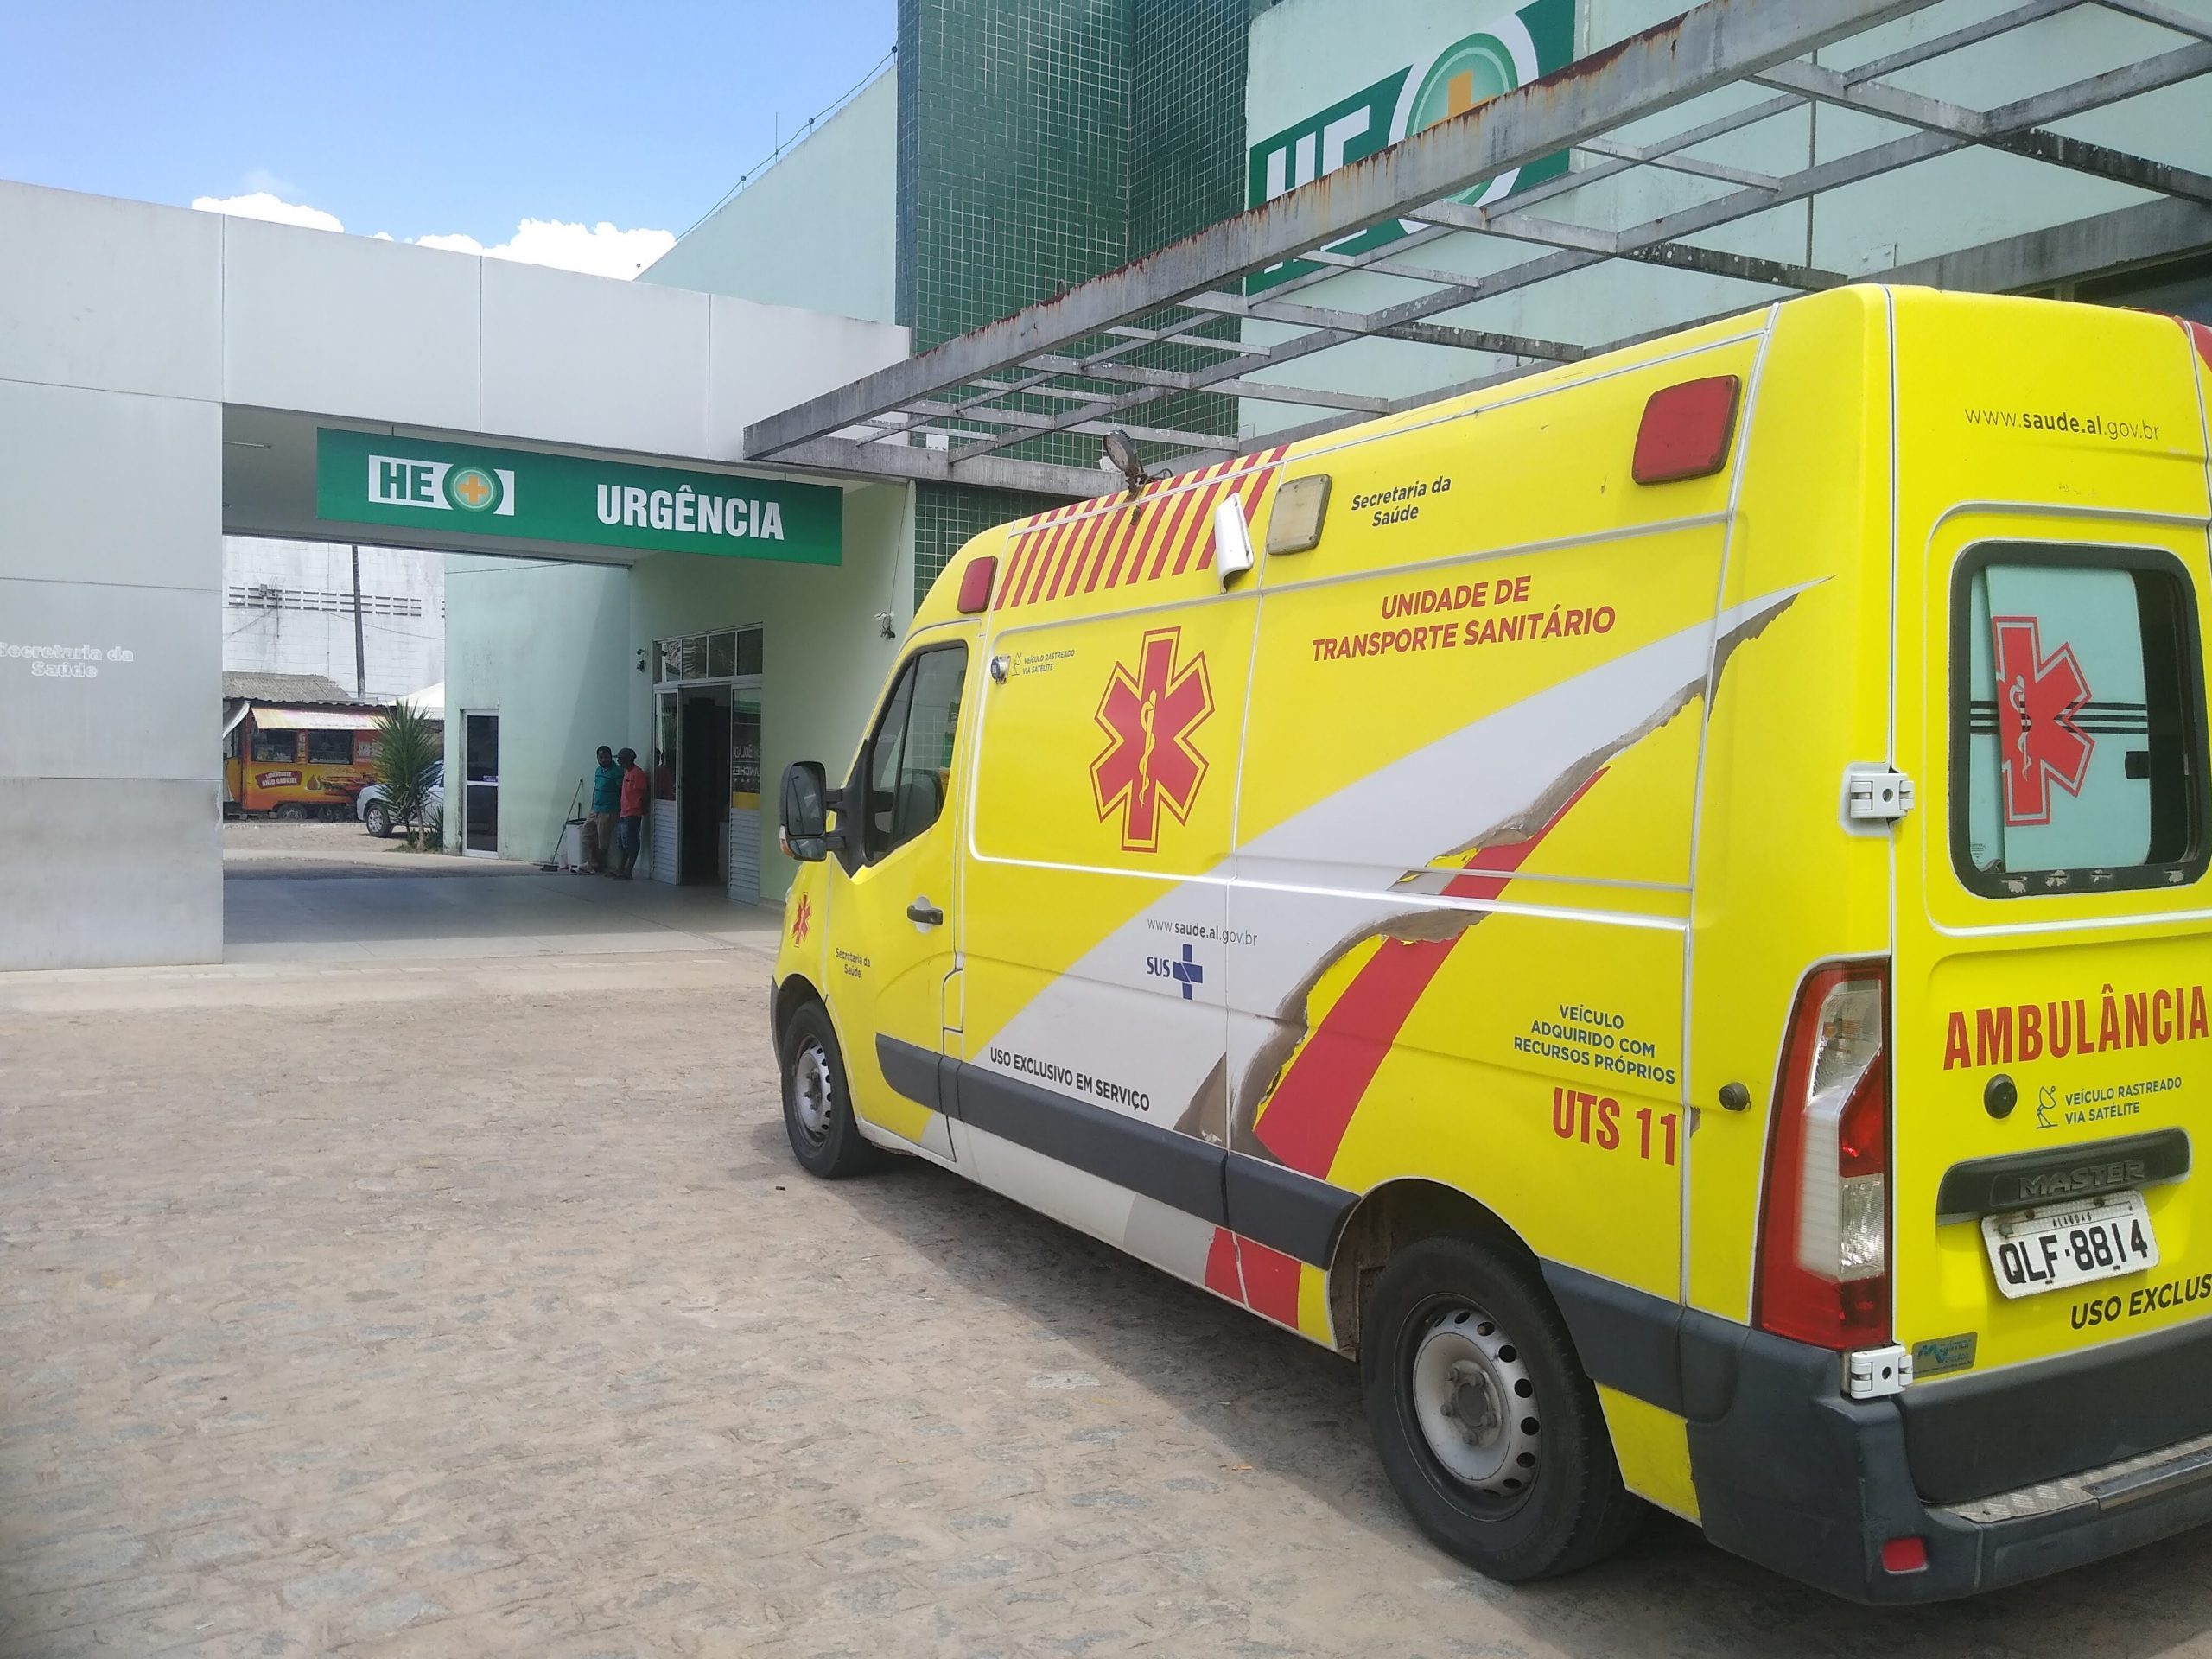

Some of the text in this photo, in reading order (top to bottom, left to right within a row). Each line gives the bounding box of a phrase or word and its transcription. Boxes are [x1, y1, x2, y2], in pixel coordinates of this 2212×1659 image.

[1964, 409, 2159, 441] www.saude.al.gov.br
[1351, 475, 1452, 511] Secretaria da
[596, 484, 785, 541] URGÊNCIA
[1372, 504, 1419, 527] Saúde
[1382, 575, 1531, 620] UNIDADE DE
[1313, 604, 1616, 661] TRANSPORTE SANITÁRIO
[0, 642, 134, 662] Secretaria da
[1024, 650, 1075, 664] VEÍCULO RASTREADO
[31, 661, 99, 678] Saúde
[1032, 663, 1053, 673] SATÉLITE
[1147, 918, 1258, 946] www.saude.al.gov.br
[836, 947, 871, 968] Secretaria da
[844, 963, 861, 979] Saúde
[1147, 956, 1170, 978] SUS
[1559, 1004, 1624, 1029] VEÍCULO
[1943, 983, 2209, 1071] AMBULÂNCIA
[1531, 1020, 1655, 1058] ADQUIRIDO COM
[1514, 1037, 1675, 1084] RECURSOS PRÓPRIOS
[990, 1046, 1150, 1112] USO EXCLUSIVO EM SERVIÇO
[2065, 1077, 2182, 1106] VEÍCULO RASTREADO
[1553, 1086, 1677, 1166] UTS 11
[2065, 1102, 2139, 1124] VIA SATÉLITE
[2018, 1160, 2145, 1199] MASTER
[2071, 1274, 2212, 1329] USO EXCLUS
